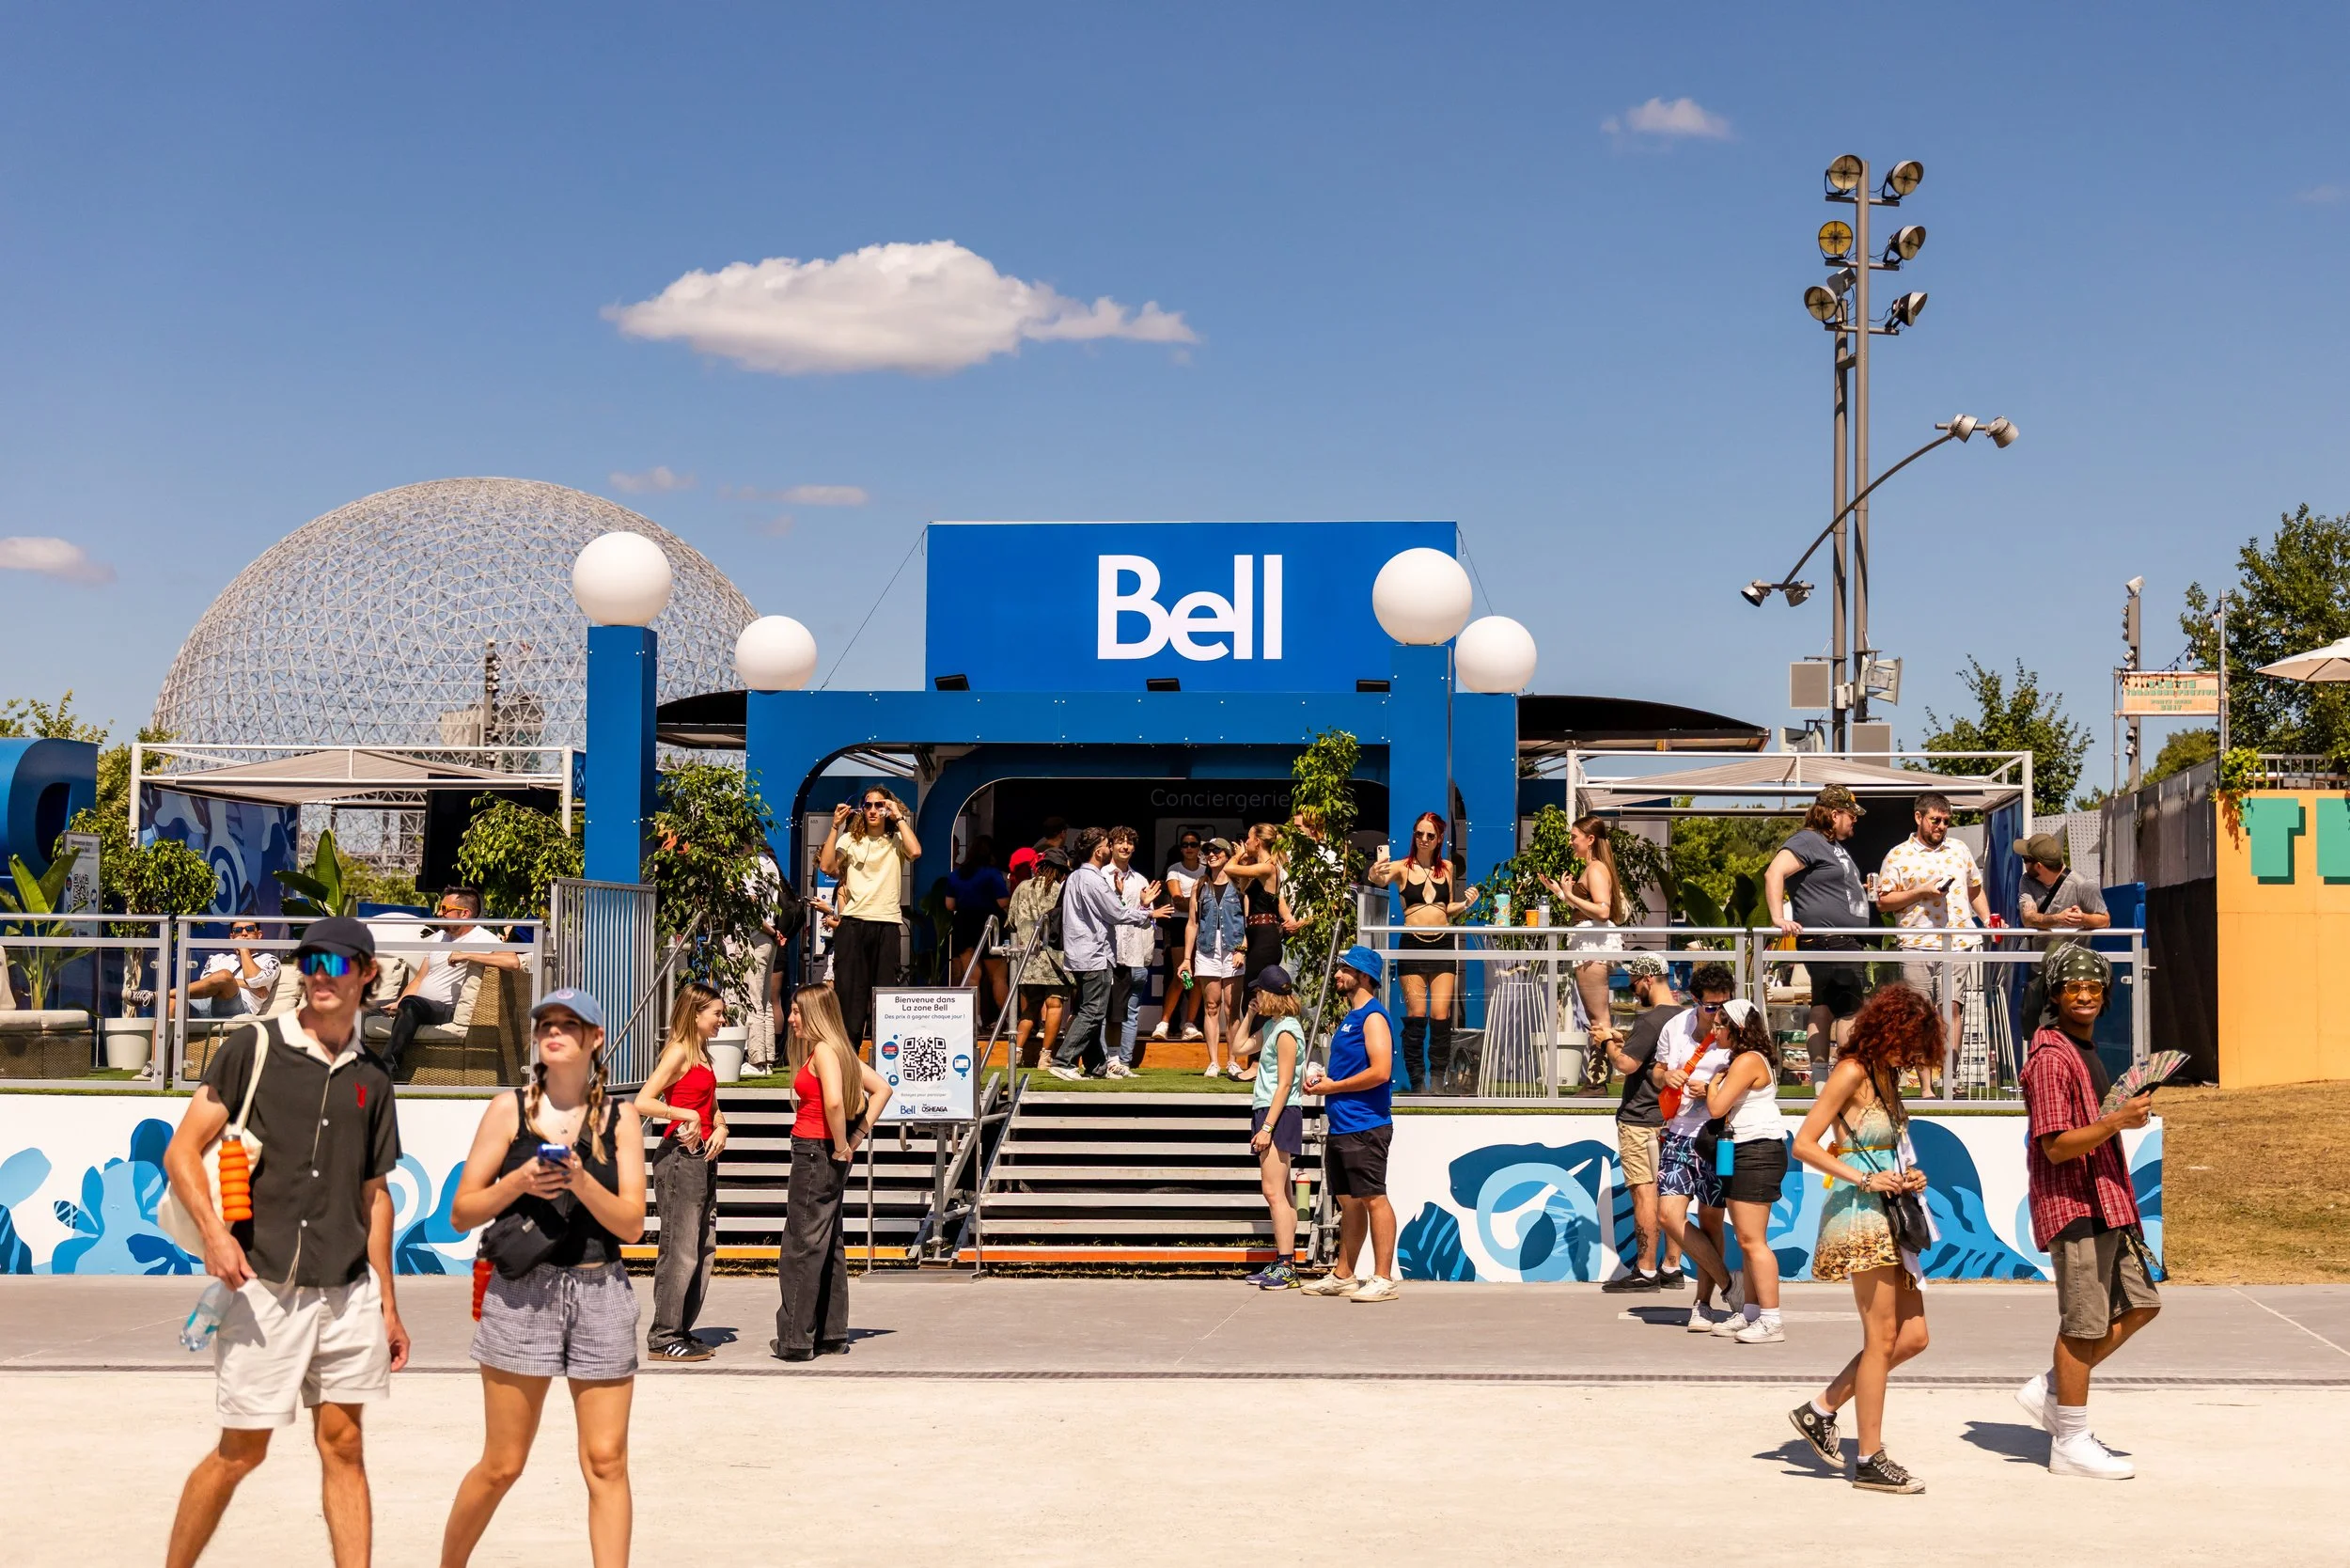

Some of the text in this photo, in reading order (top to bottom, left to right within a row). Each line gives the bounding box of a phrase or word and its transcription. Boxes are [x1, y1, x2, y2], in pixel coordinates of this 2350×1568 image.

[1097, 554, 1283, 661] Bell
[1151, 789, 1291, 813] Conciergerie
[900, 1105, 916, 1114] Bell
